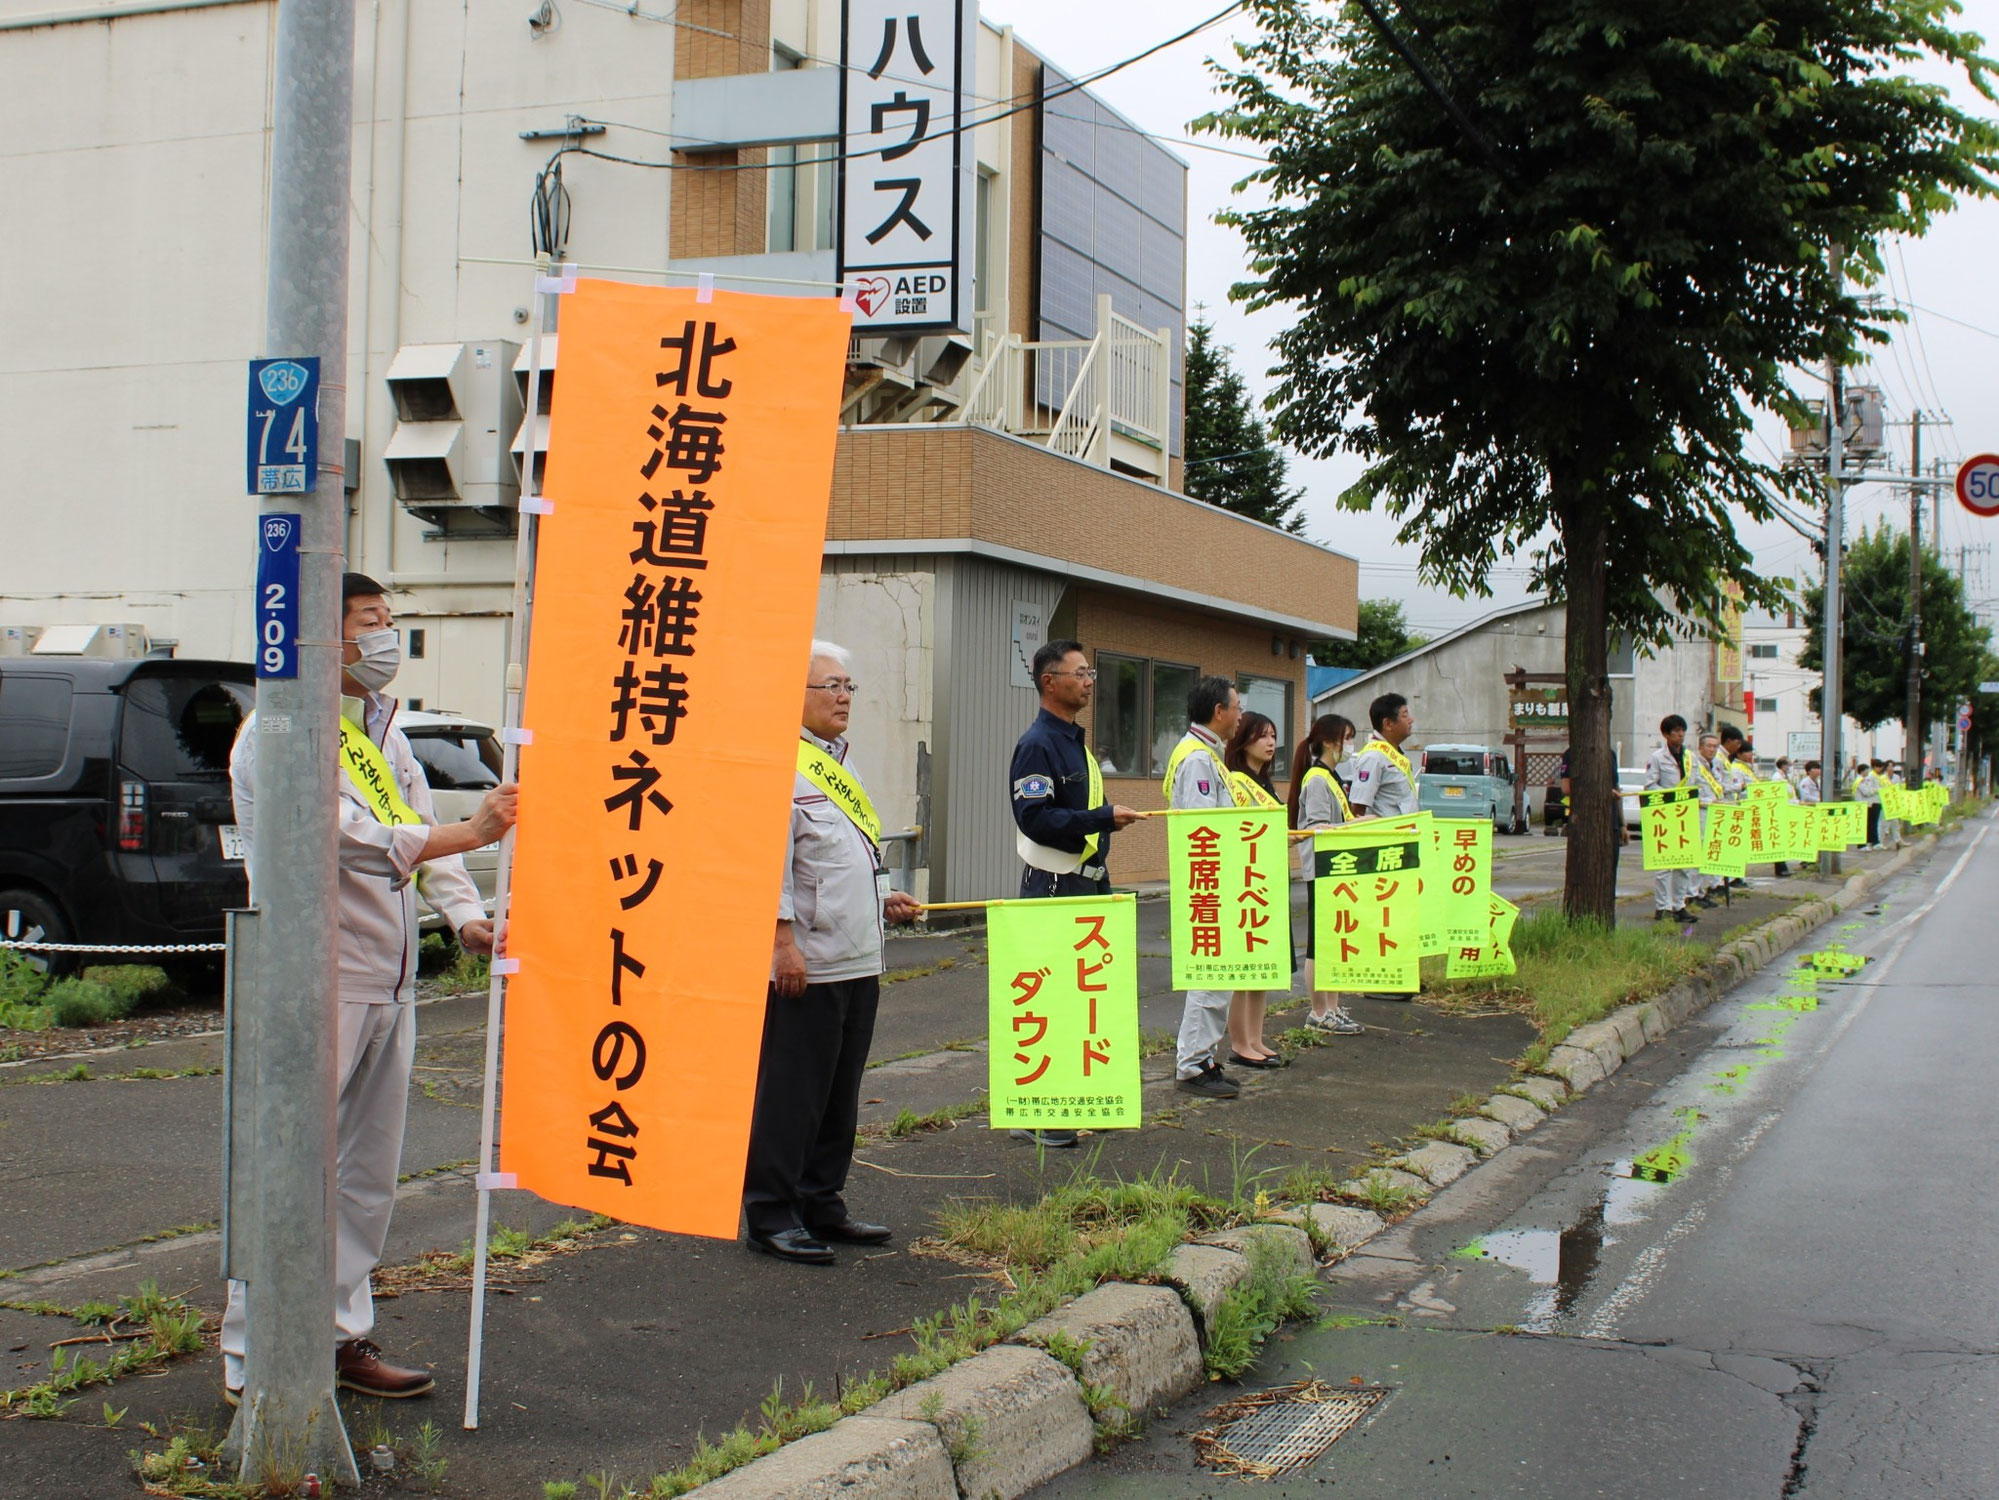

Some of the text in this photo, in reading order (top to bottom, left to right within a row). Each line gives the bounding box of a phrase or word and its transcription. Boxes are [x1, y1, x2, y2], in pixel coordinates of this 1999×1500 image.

[865, 15, 935, 245] ハウス
[894, 275, 947, 295] AED
[895, 298, 927, 315] 設置
[266, 368, 299, 392] 236
[256, 407, 307, 464] 74
[261, 467, 302, 490] 帯広
[1970, 471, 1999, 498] 50
[267, 523, 286, 537] 236
[587, 320, 737, 1187] 北海道維持ネットの会
[1652, 807, 1668, 854] ベルト
[1675, 804, 1690, 849] シート
[1707, 810, 1726, 861] ライト点灯
[1728, 810, 1745, 848] 早めの
[1767, 802, 1780, 849] シートベルト
[1803, 810, 1814, 849] スピード
[1329, 847, 1404, 876] 全席
[1452, 829, 1478, 896] 早めの
[1187, 826, 1222, 957] 全席着用
[1237, 821, 1270, 953] シートベルト
[1333, 881, 1360, 962] ベルト
[1375, 877, 1399, 957] シート
[1073, 916, 1113, 1077] スピード
[1011, 967, 1051, 1086] ダウン
[1005, 1107, 1125, 1117] 帯広市交通安全協会
[1006, 1096, 1124, 1106] (一財)帯広地方交通安全協会
